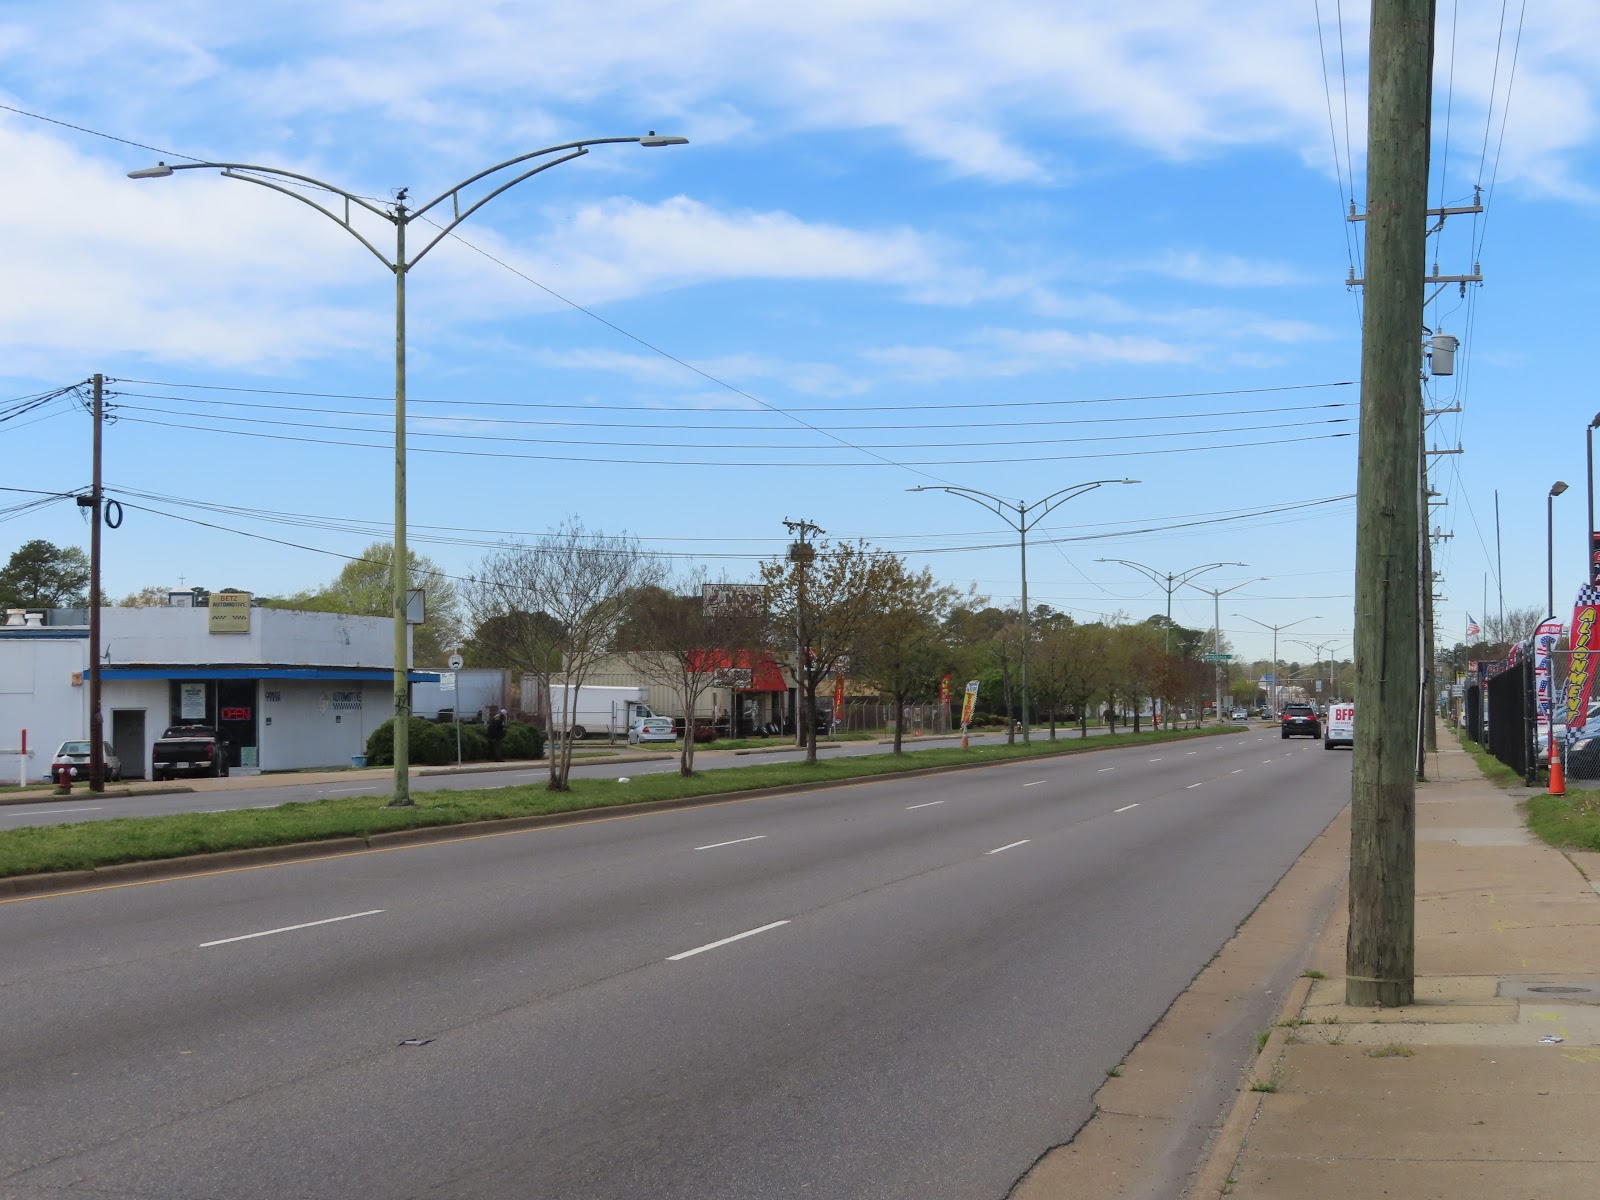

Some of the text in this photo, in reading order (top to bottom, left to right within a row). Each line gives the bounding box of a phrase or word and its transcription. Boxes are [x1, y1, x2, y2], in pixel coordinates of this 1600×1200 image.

[1540, 625, 1561, 633] HOLIDAY
[1567, 607, 1596, 725] ALIGNMENT
[222, 708, 250, 720] OPEN
